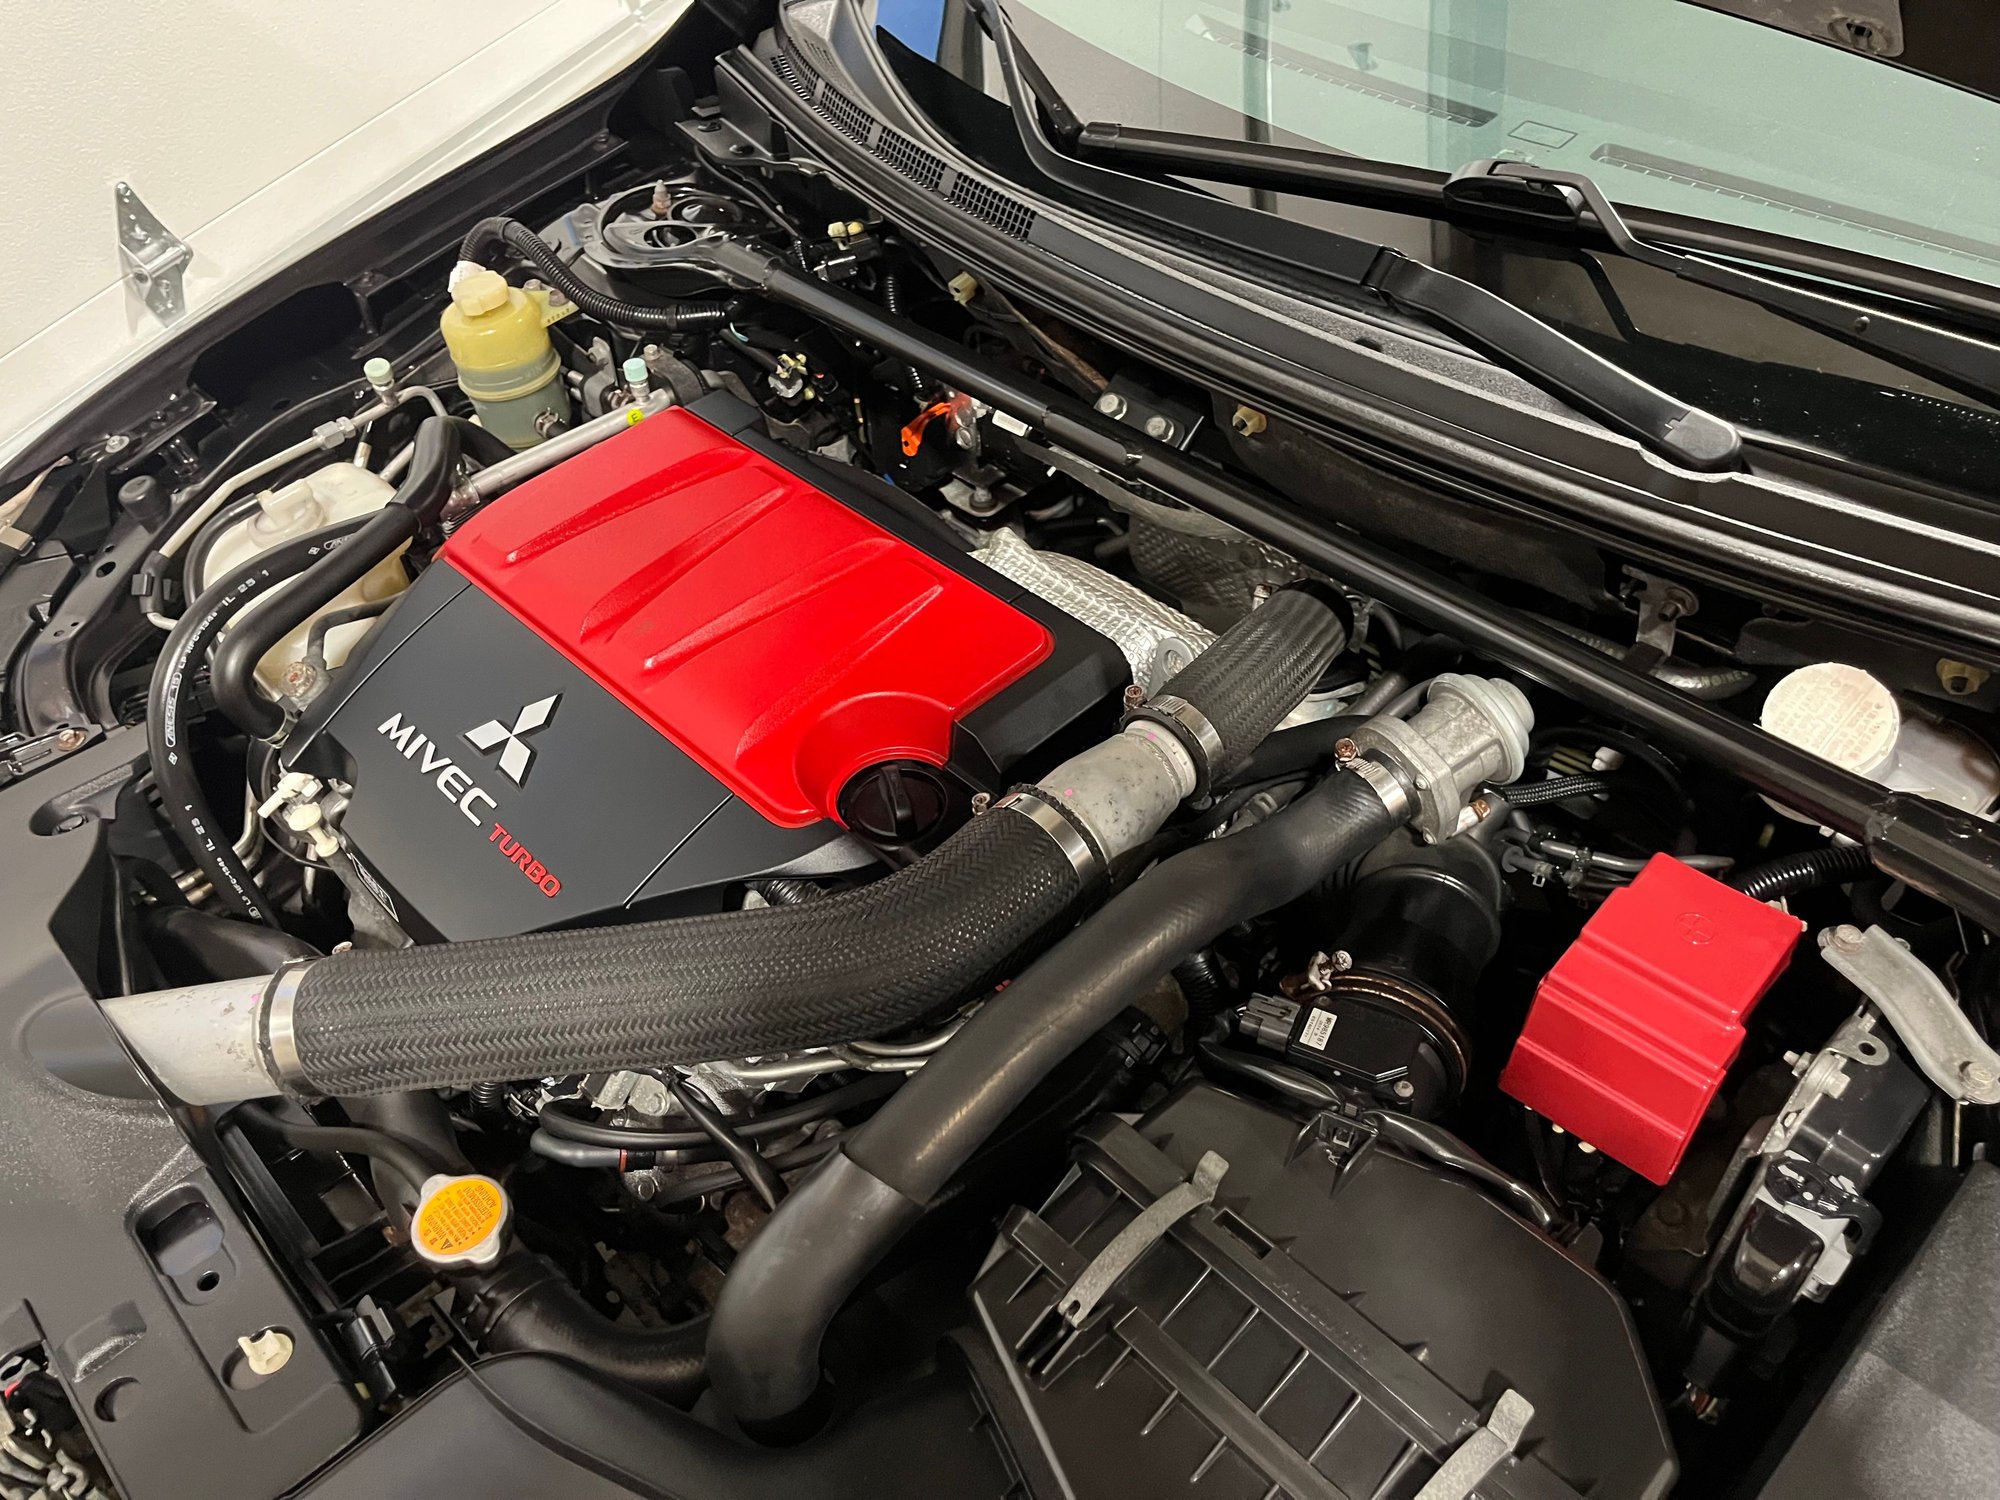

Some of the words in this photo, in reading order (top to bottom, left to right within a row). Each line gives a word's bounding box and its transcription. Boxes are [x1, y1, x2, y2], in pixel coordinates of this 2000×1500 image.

[631, 412, 639, 422] E
[221, 596, 236, 607] IL
[377, 712, 498, 827] MIVEC
[206, 838, 216, 852] IL
[489, 822, 562, 898] TURBO
[475, 1185, 497, 1208] ACHTUNG
[425, 1214, 447, 1240] WARNING
